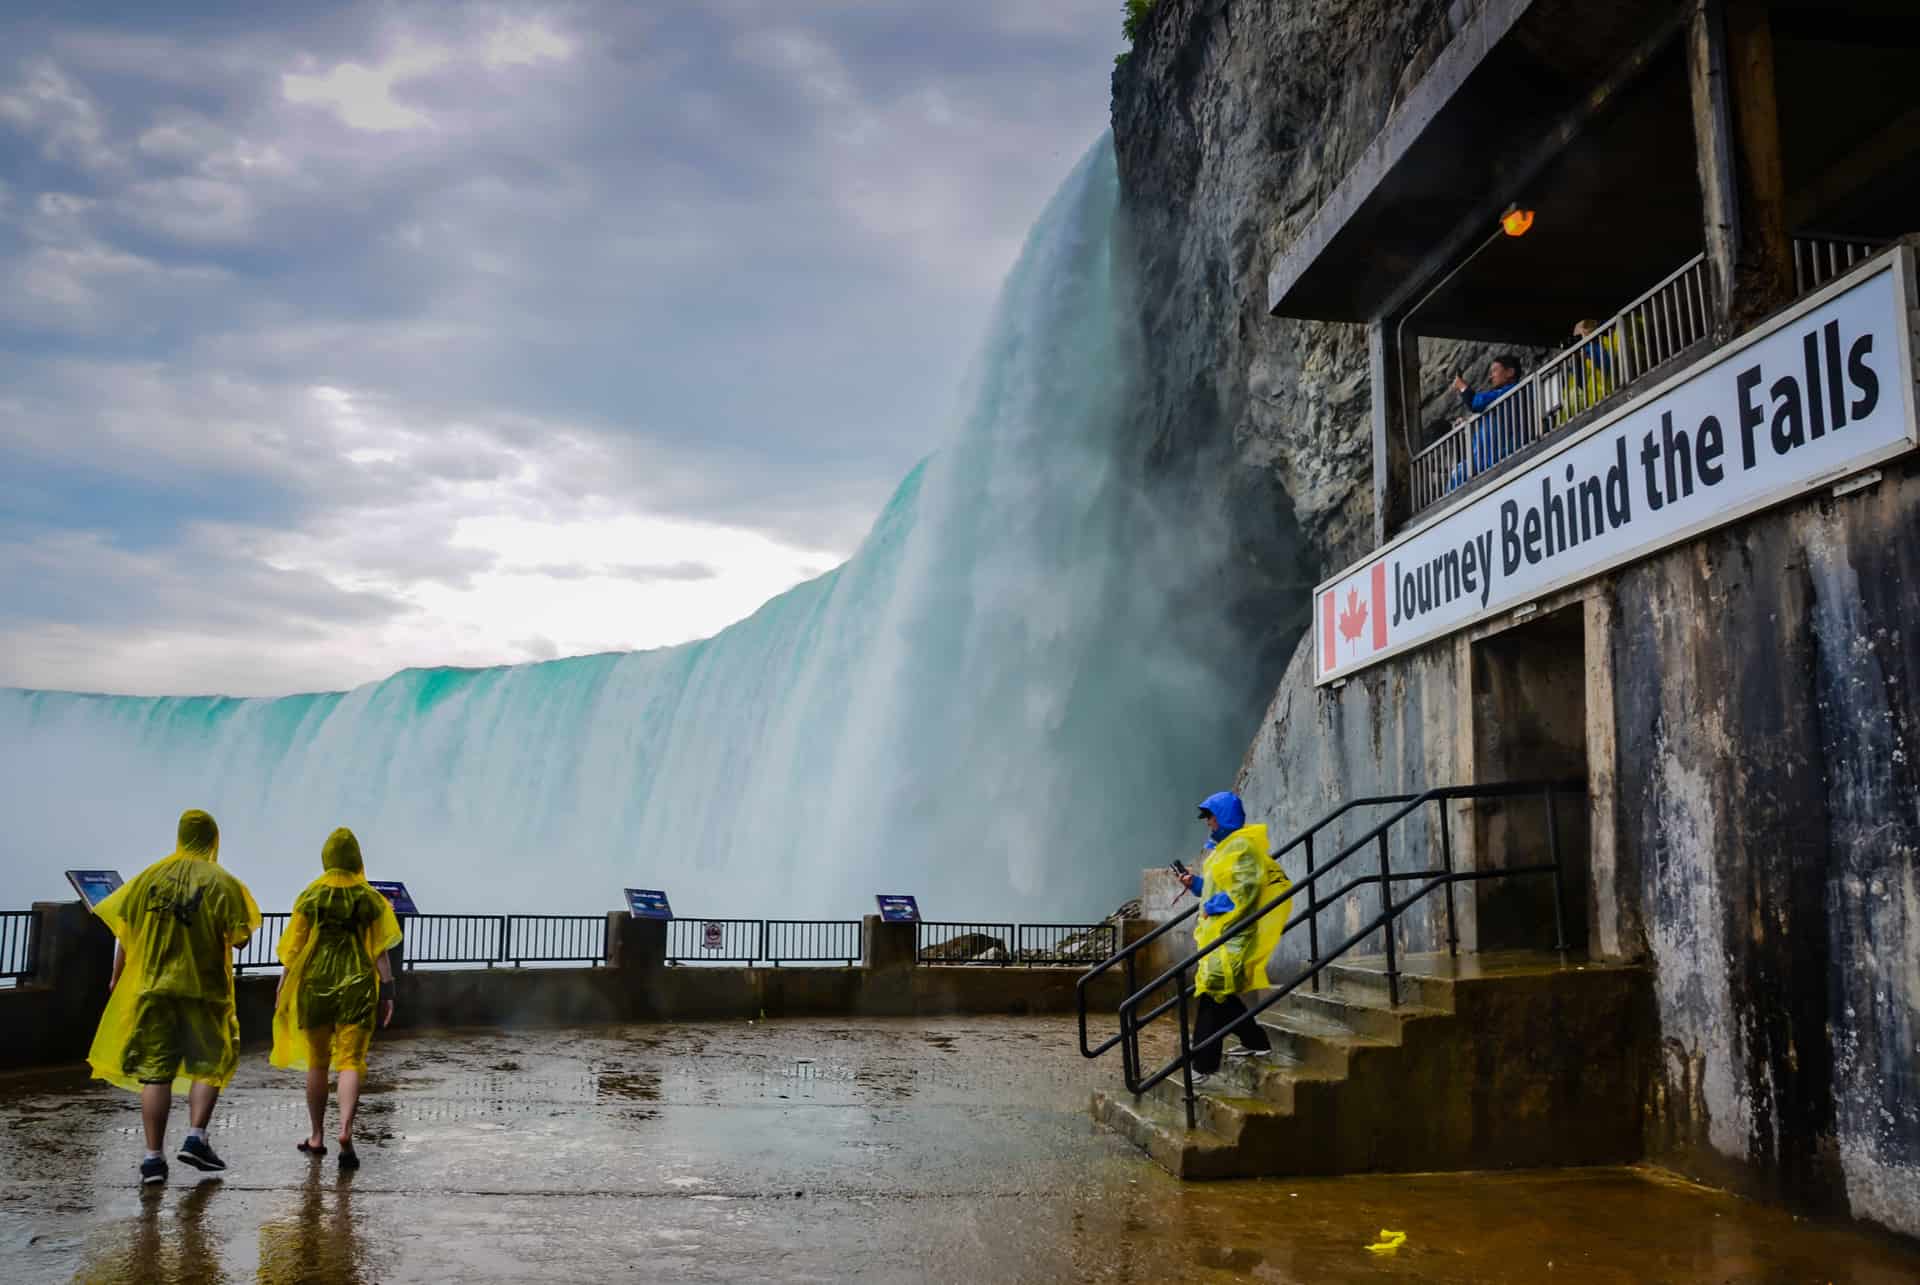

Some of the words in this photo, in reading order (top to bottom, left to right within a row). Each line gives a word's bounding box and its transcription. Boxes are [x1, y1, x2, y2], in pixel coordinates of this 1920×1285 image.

[1393, 529, 1493, 627] Journey
[1500, 435, 1632, 577] Behind
[1640, 409, 1725, 512] the
[1736, 317, 1880, 472] Falls
